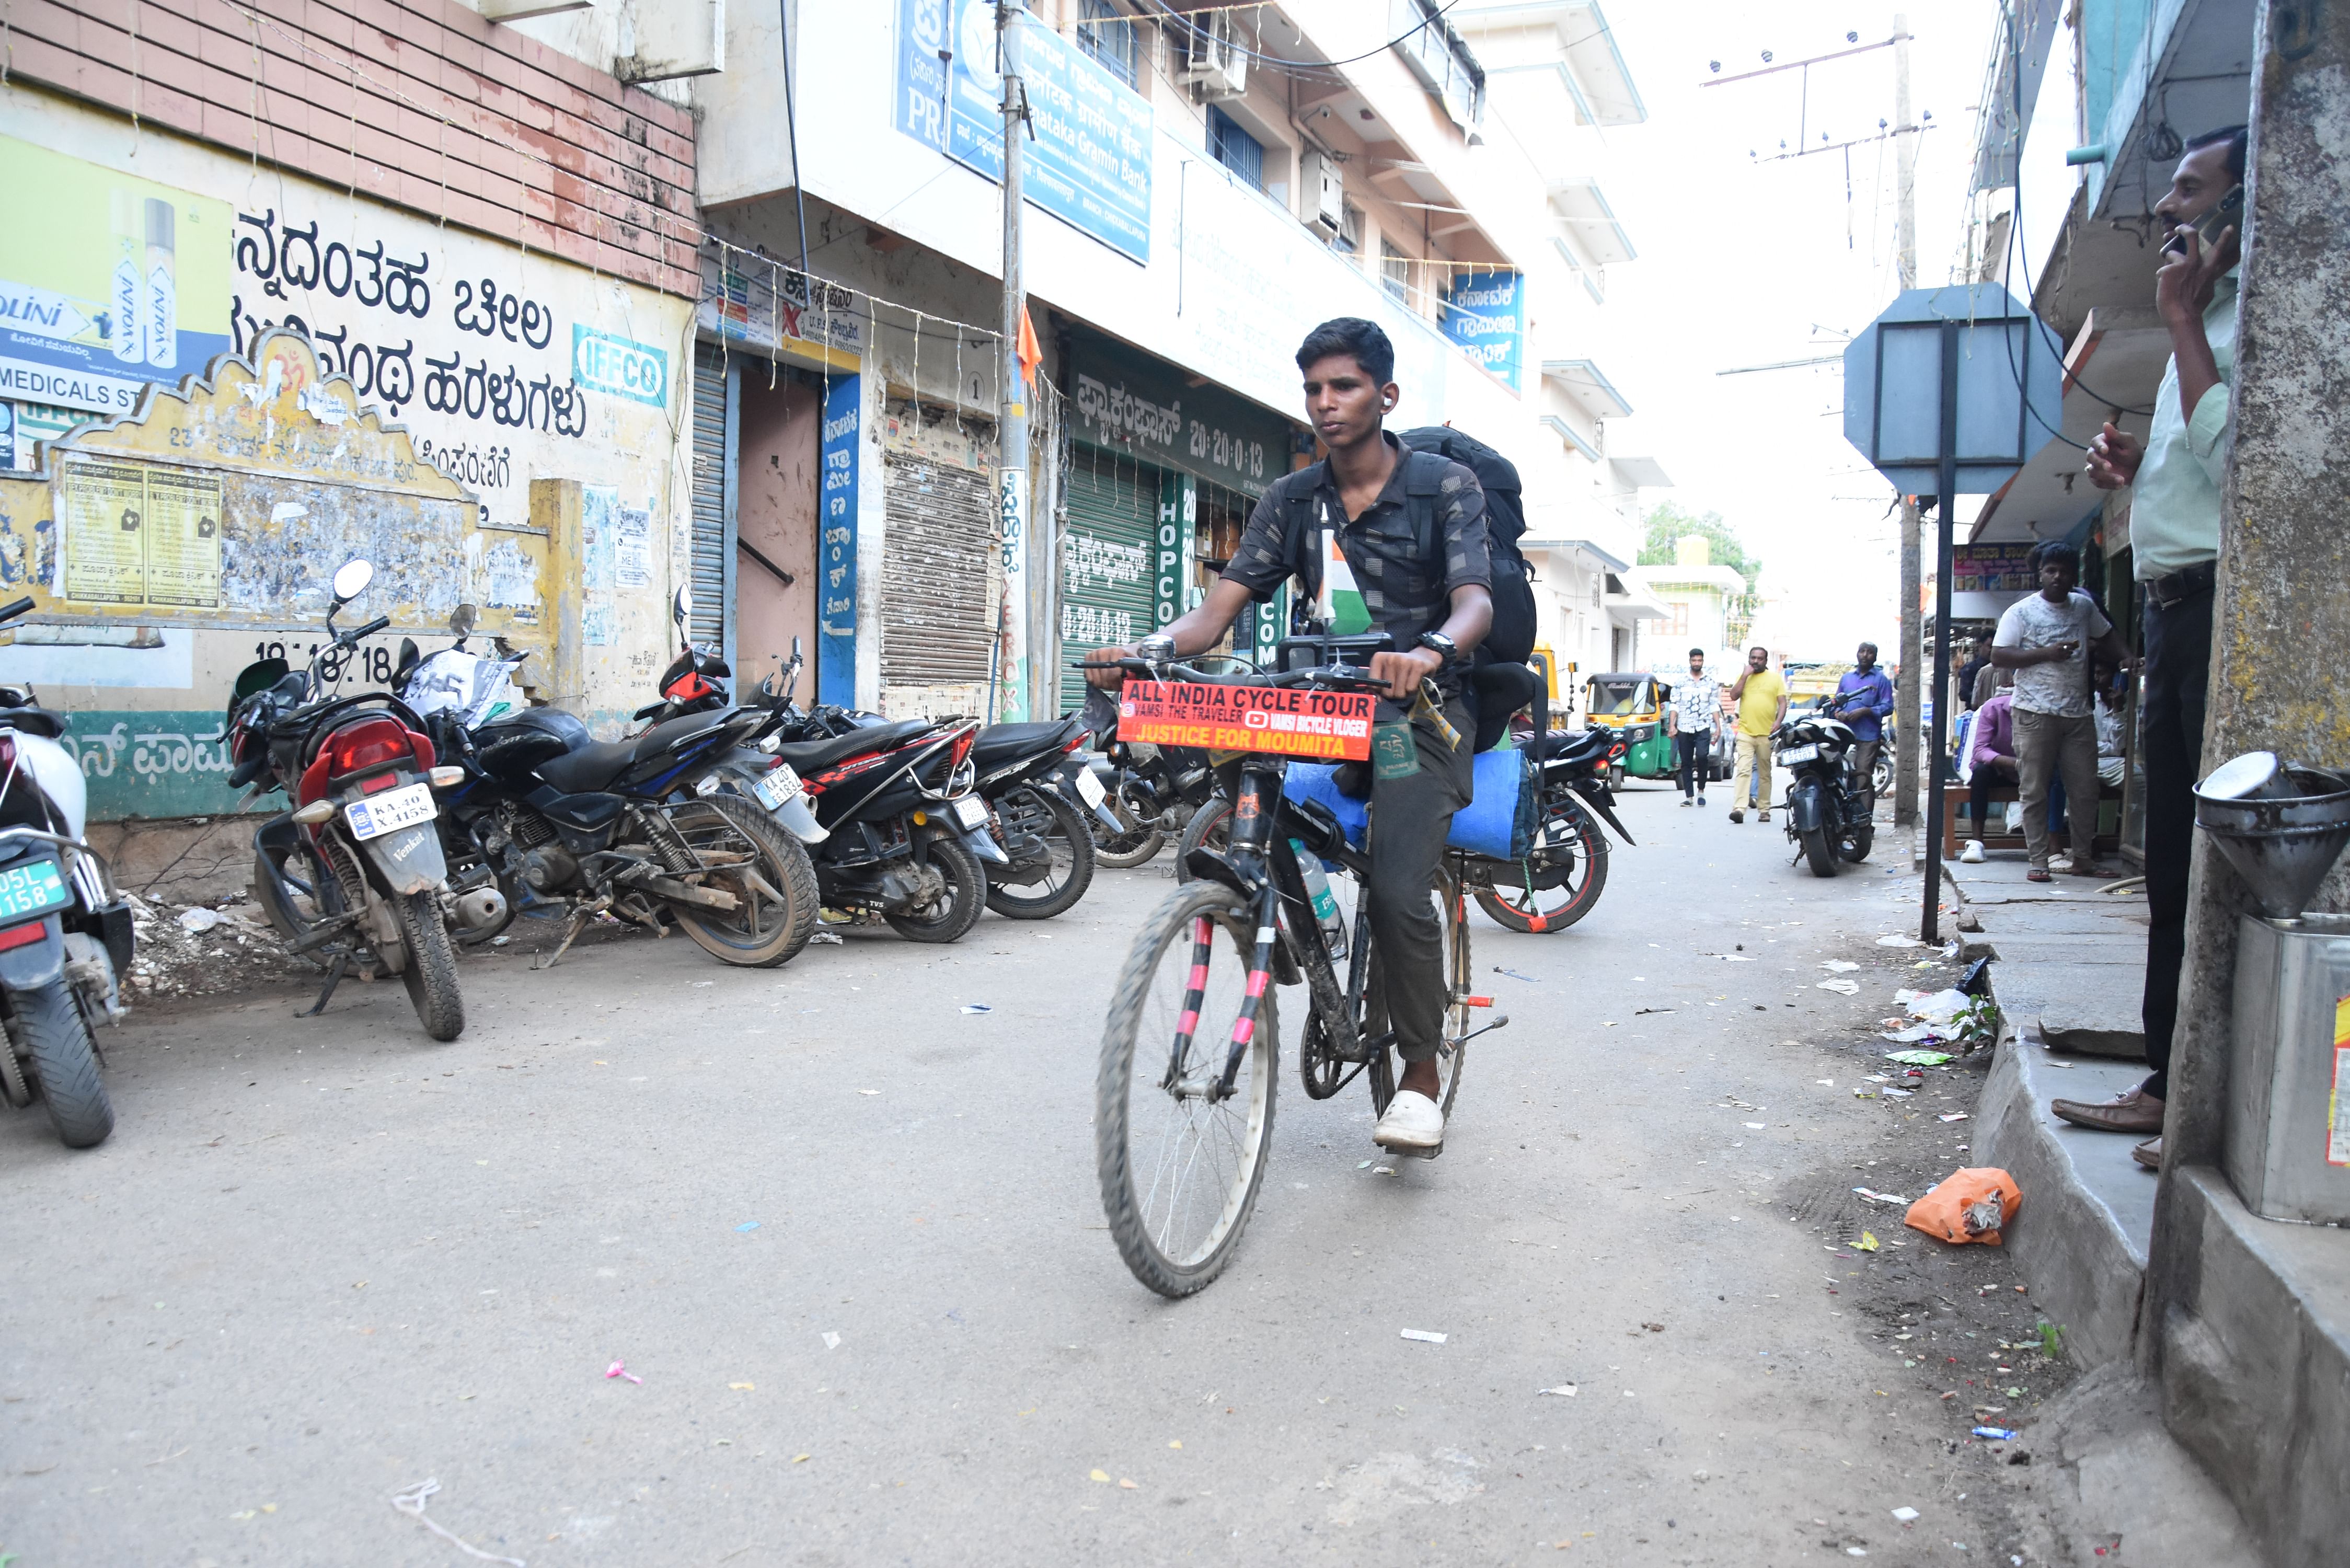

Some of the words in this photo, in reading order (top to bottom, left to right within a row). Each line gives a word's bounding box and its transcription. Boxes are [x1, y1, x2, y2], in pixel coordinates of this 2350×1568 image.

[907, 86, 942, 145] PR
[1078, 131, 1118, 177] Gramin
[1121, 156, 1147, 195] Bank
[232, 208, 430, 319] ನ್ನದಂತಹ
[585, 340, 655, 390] IFFCO
[0, 367, 110, 405] MEDICALS
[424, 351, 586, 438] ಹರಳುಗಳು
[1158, 502, 1177, 634] HOPCO
[1128, 682, 1165, 704] ALL
[1171, 685, 1225, 707] INDIA
[1233, 687, 1303, 711] CYCLE
[1310, 695, 1369, 718] TOUR
[1136, 724, 1211, 745] JUSTICE
[1214, 728, 1252, 748] FOR
[1255, 731, 1345, 756] MOUMITA
[1270, 712, 1298, 732] VAMSI
[1298, 714, 1331, 734] BICYCLE
[1333, 718, 1367, 737] VLOGER
[763, 777, 778, 792] KA
[779, 769, 789, 786] 40
[374, 795, 420, 816] KA.40
[376, 804, 429, 828] X.4158
[392, 831, 426, 863] Venkat
